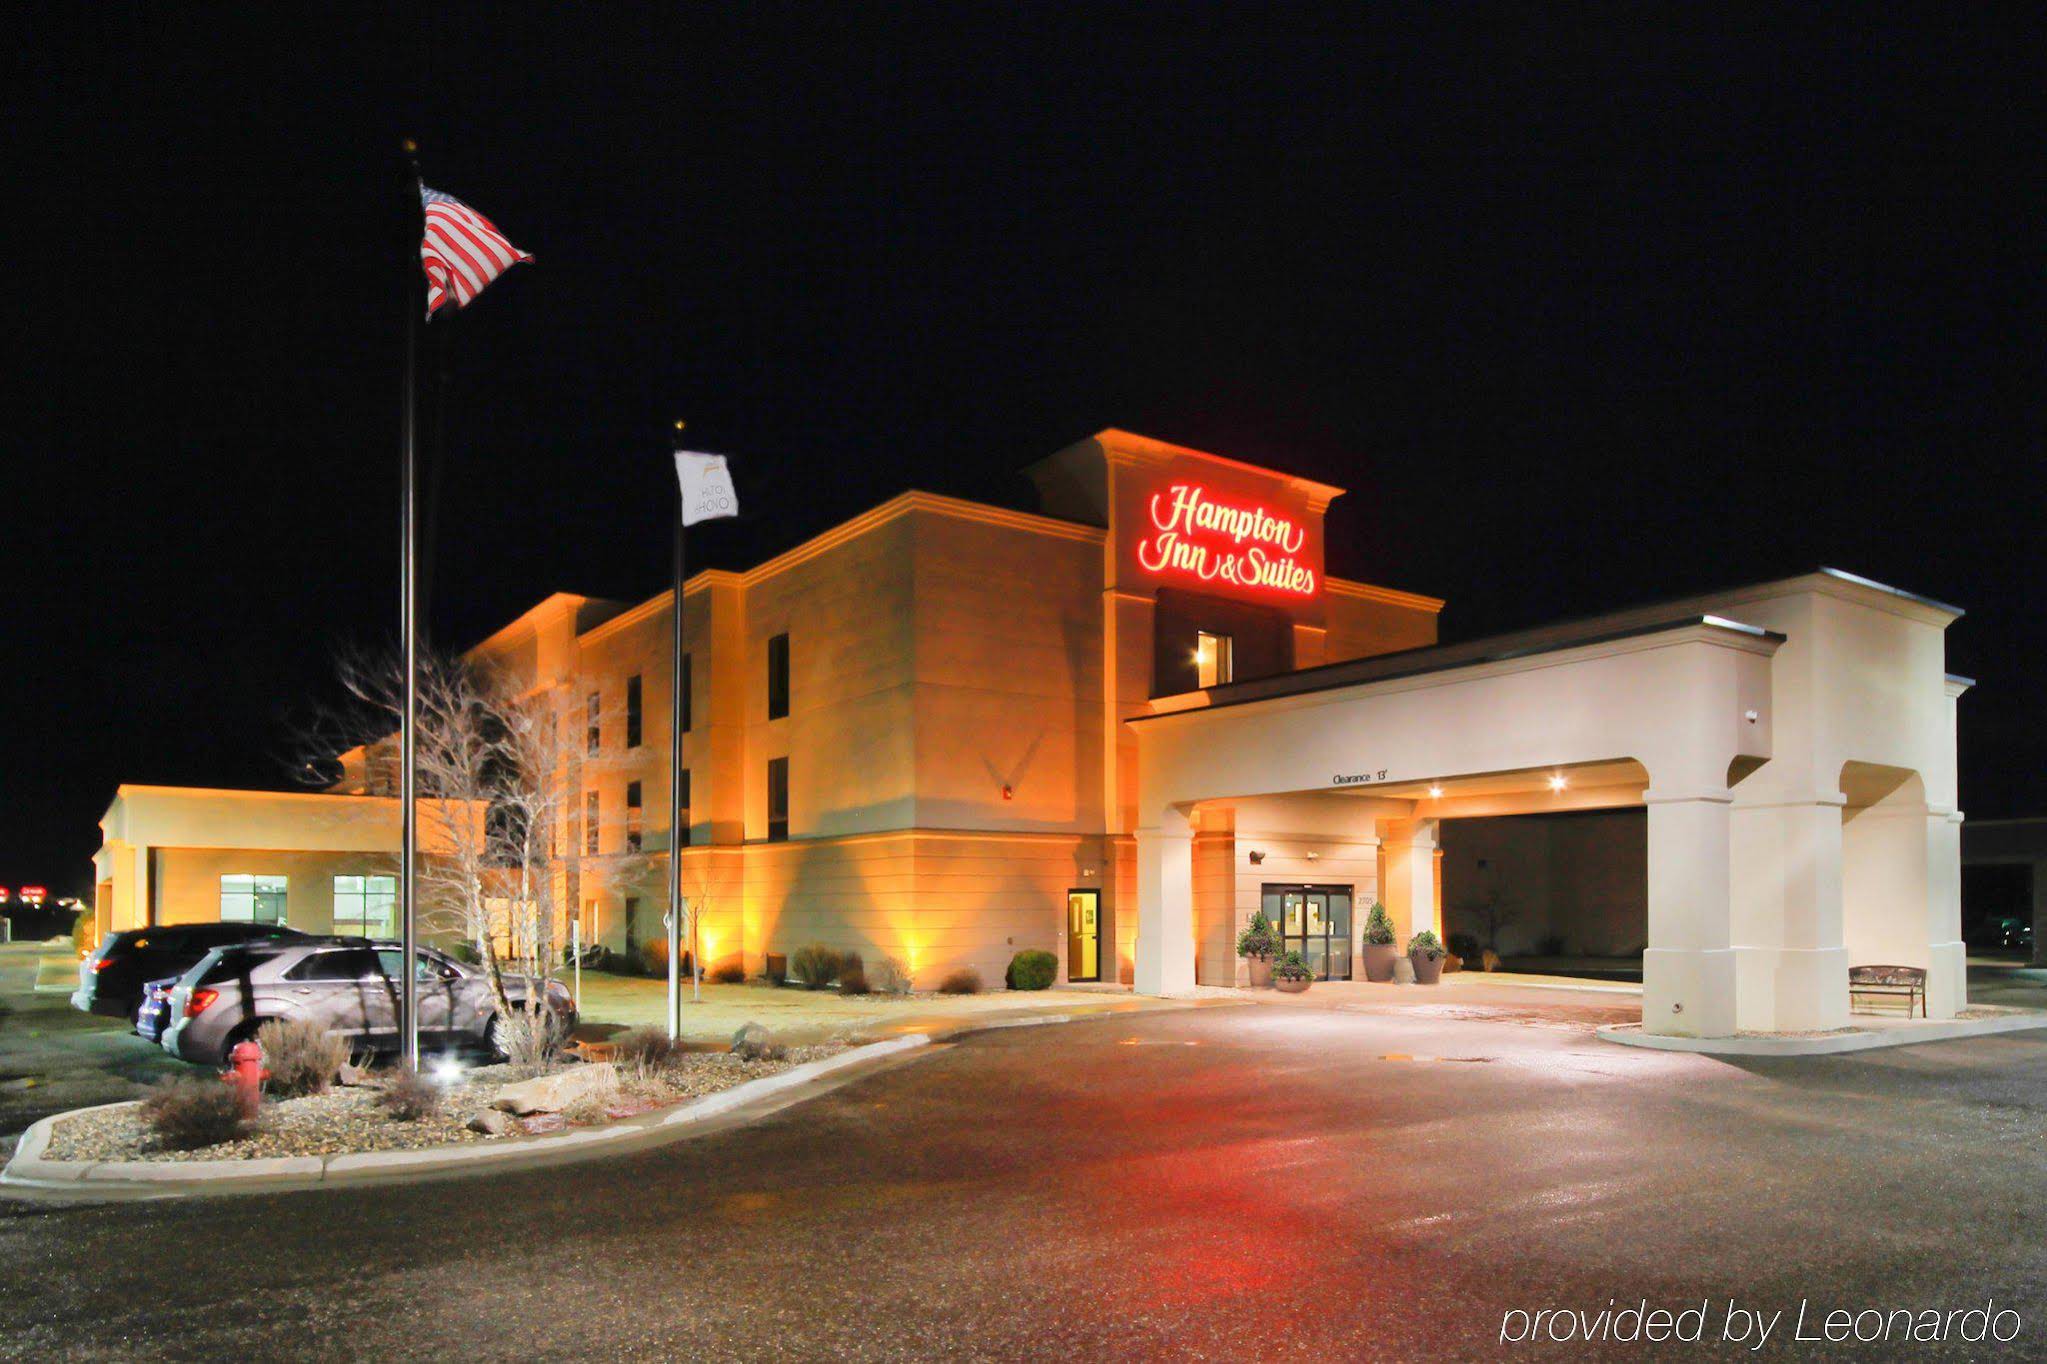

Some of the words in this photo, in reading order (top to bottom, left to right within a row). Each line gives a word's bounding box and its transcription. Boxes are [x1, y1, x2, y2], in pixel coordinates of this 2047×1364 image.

[1151, 485, 1304, 553] Hampton
[1138, 532, 1221, 580] Inn
[1219, 553, 1240, 585] &
[1236, 547, 1315, 594] Suites
[1332, 773, 1371, 785] Clearance
